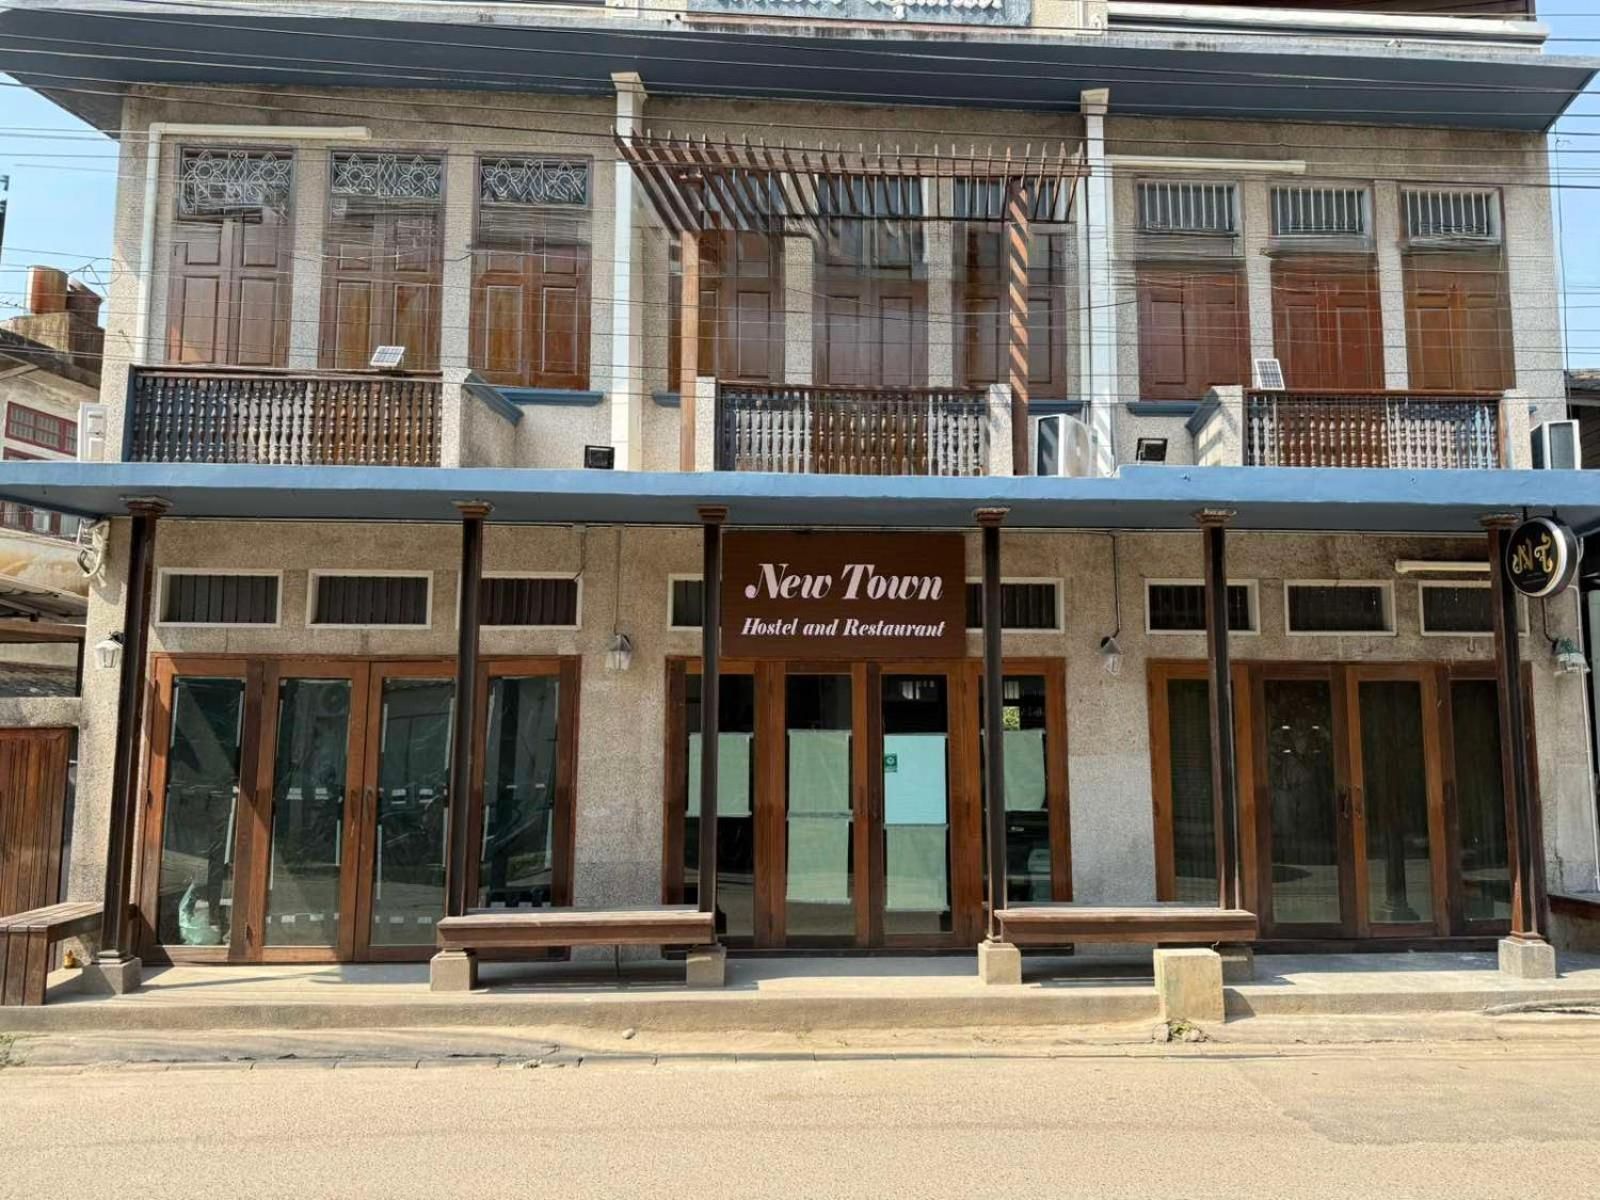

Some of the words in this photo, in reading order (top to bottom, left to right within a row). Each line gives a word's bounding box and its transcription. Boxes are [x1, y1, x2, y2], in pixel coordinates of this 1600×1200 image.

[744, 563, 832, 599] New
[841, 563, 943, 600] Town
[741, 617, 799, 636] Hostel
[802, 618, 839, 636] and
[842, 618, 945, 637] Restaurant
